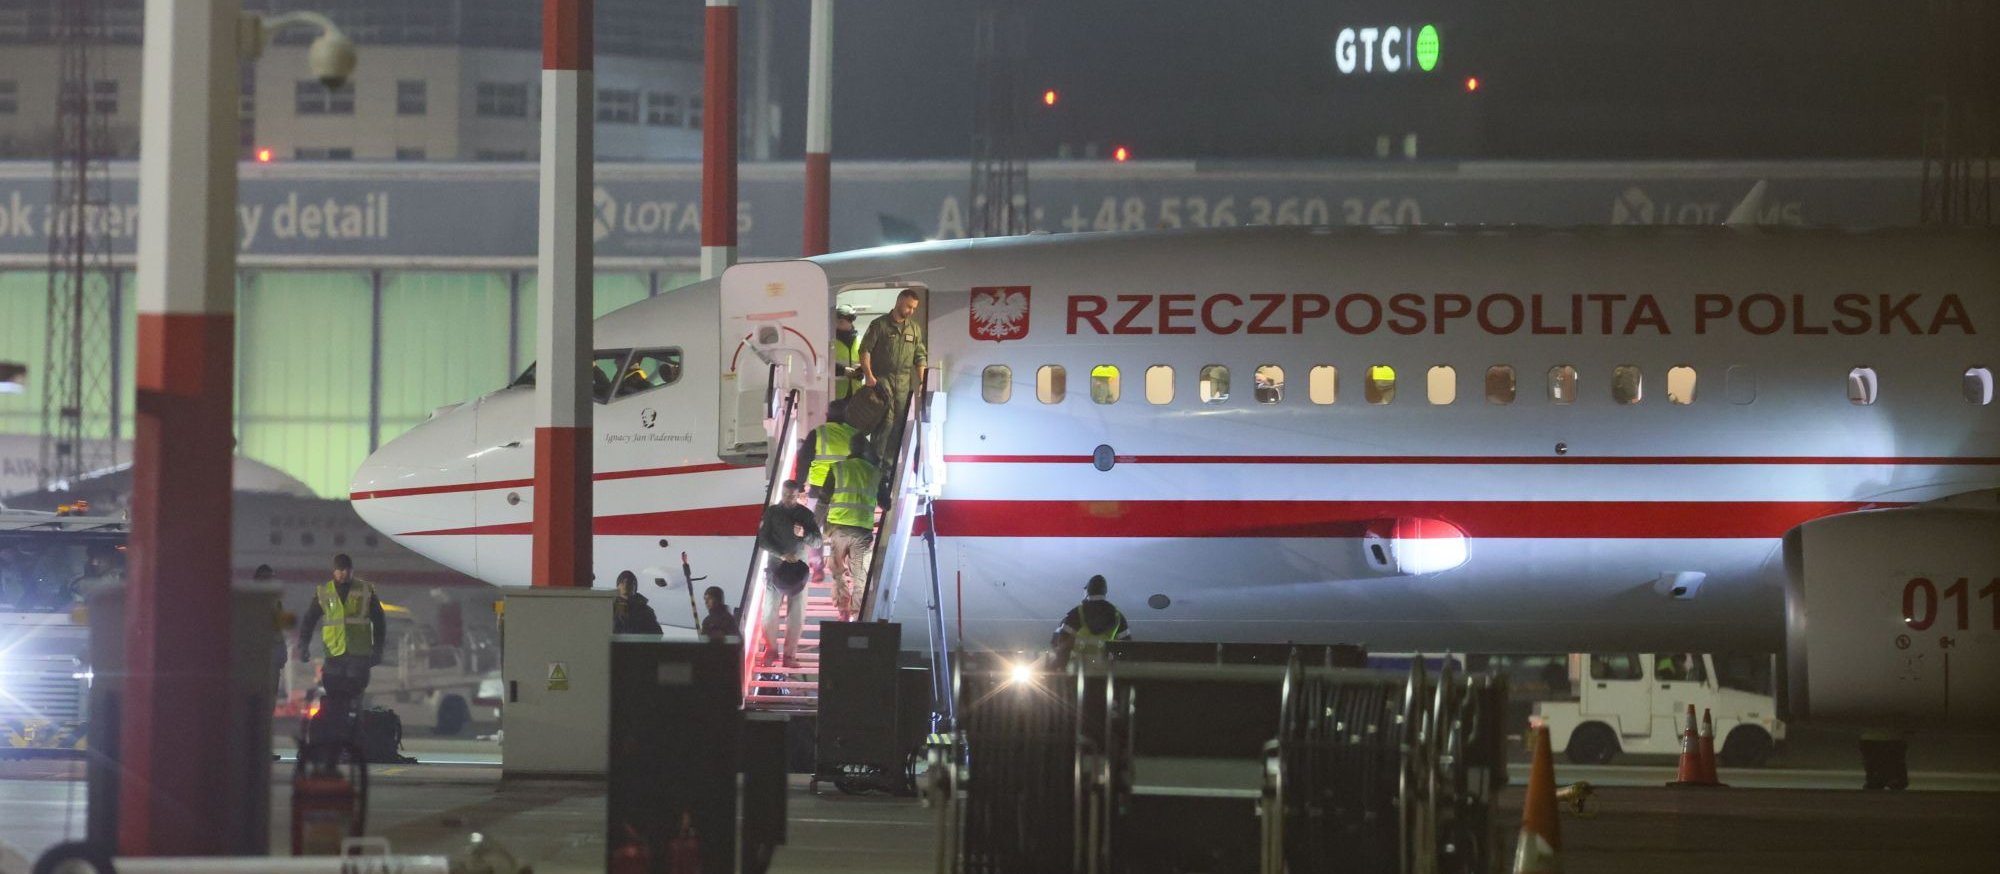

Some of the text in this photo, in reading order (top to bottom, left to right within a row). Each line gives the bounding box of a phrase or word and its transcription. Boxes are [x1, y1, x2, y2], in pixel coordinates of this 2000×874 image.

[1336, 26, 1401, 73] GTC
[272, 192, 388, 238] detail
[623, 202, 752, 233] LOT AS
[1160, 196, 1237, 228] 536
[1066, 293, 1976, 336] RZECZPOSPOLITA POLSKA
[1902, 577, 2000, 631] 011
